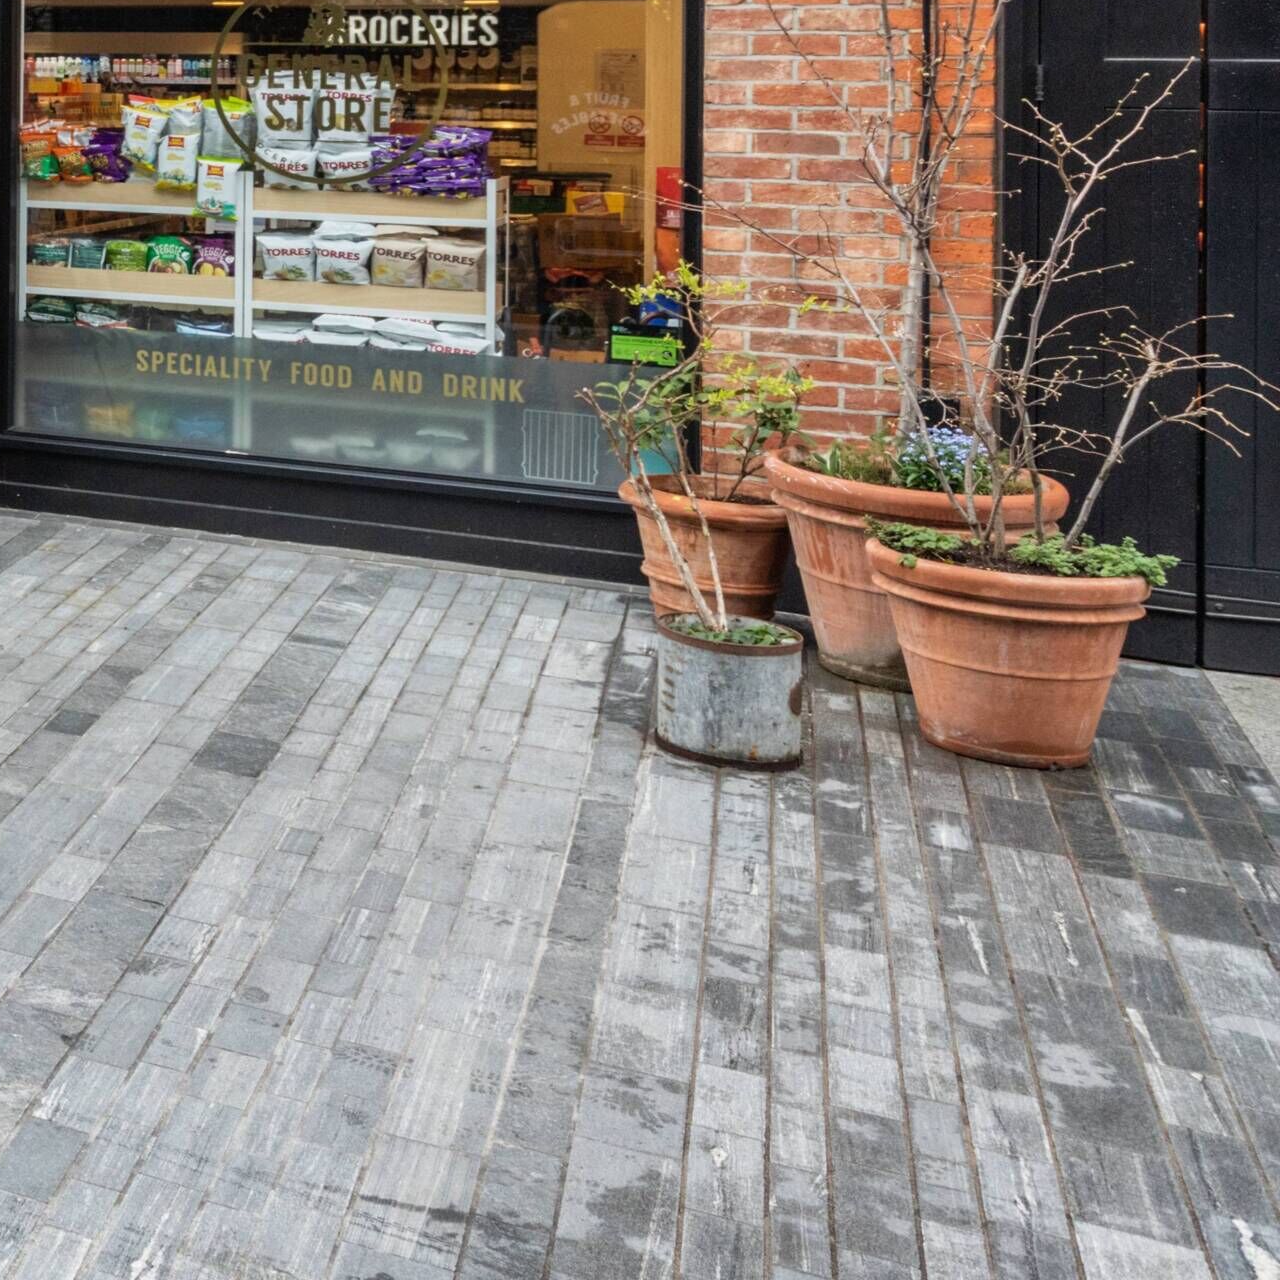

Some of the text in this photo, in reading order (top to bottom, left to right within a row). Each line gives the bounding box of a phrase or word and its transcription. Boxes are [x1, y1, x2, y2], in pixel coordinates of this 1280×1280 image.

[329, 14, 499, 46] ROCERIES
[240, 52, 420, 91] GENERAL
[325, 90, 372, 103] TORRES
[264, 96, 391, 133] STORE
[323, 160, 369, 172] TORRES
[266, 247, 311, 257] TORRES
[317, 248, 361, 261] TORRES
[426, 251, 476, 267] TORRES
[135, 349, 526, 404] SPECIALITY FOOD AND DRINK
